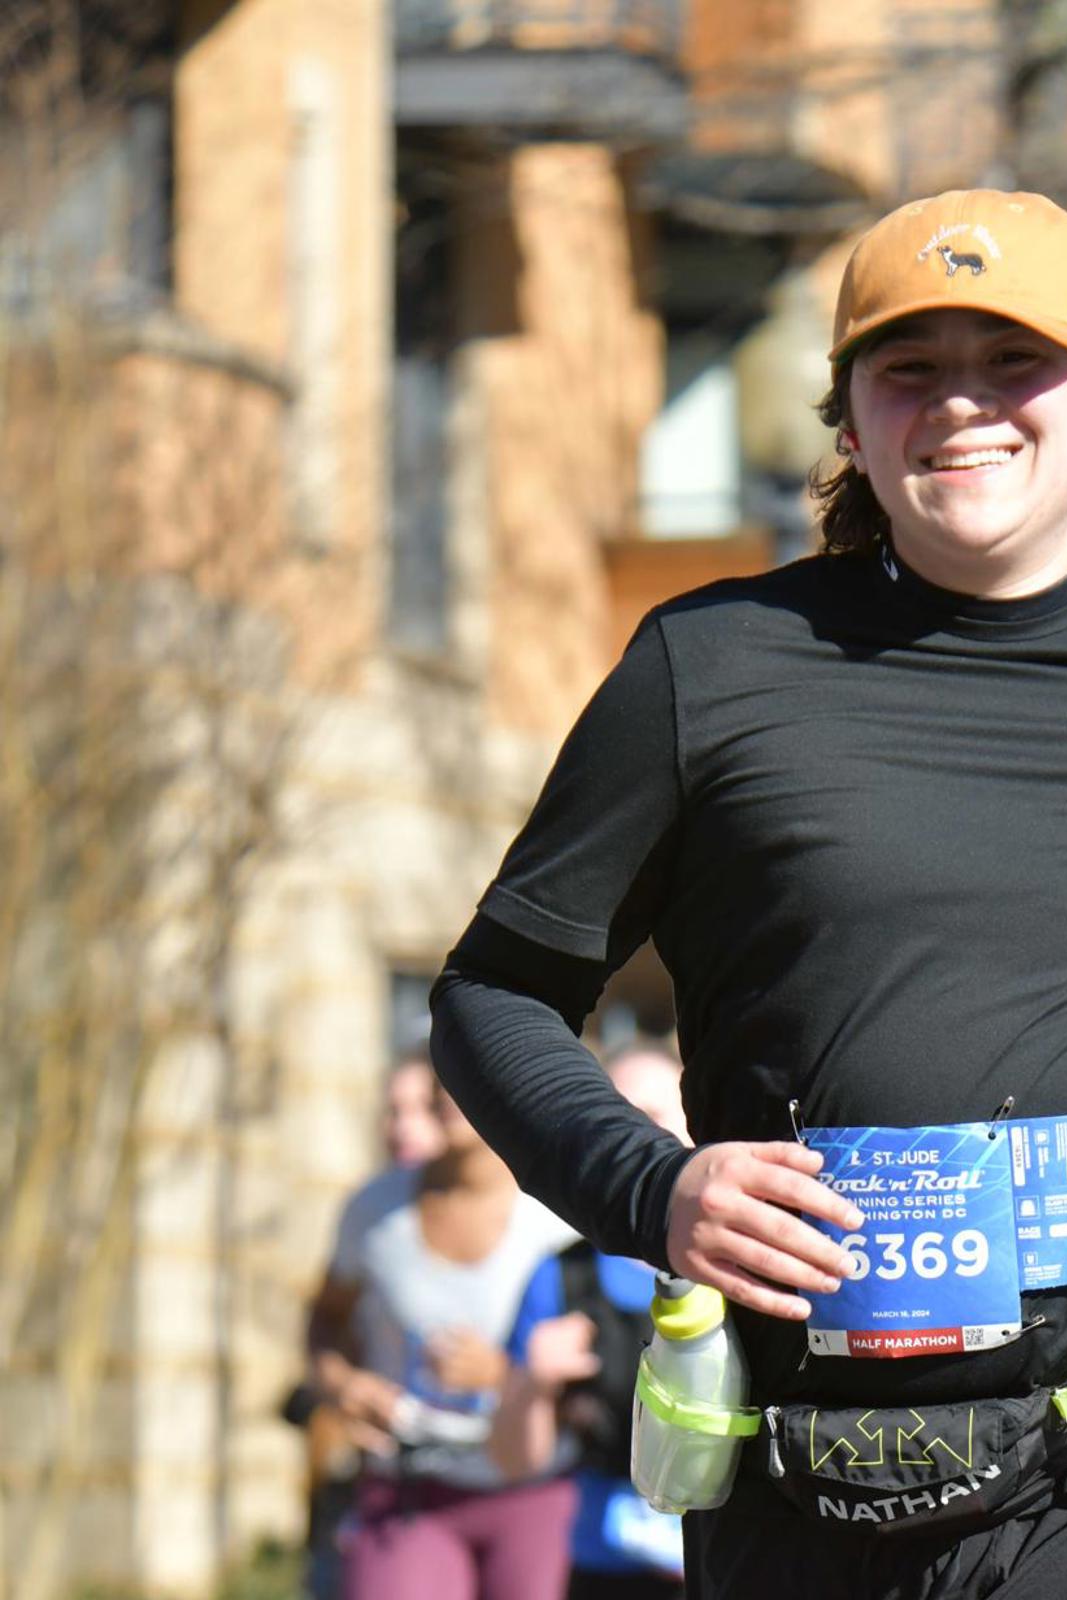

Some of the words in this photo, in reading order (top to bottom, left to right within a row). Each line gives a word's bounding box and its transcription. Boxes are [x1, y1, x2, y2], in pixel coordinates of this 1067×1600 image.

[873, 1151, 894, 1165] ST.
[897, 1150, 940, 1164] JUDE
[818, 1172, 887, 1192] Rock
[912, 1169, 982, 1191] Roll
[904, 1194, 966, 1206] SERIES
[864, 1209, 936, 1221] HINGTON
[943, 1208, 967, 1219] DC
[827, 1229, 989, 1281] 6369
[872, 1311, 899, 1319] MARCH
[852, 1338, 882, 1349] HALF
[884, 1335, 957, 1349] MARATHON
[818, 1464, 1002, 1523] NATHAN
